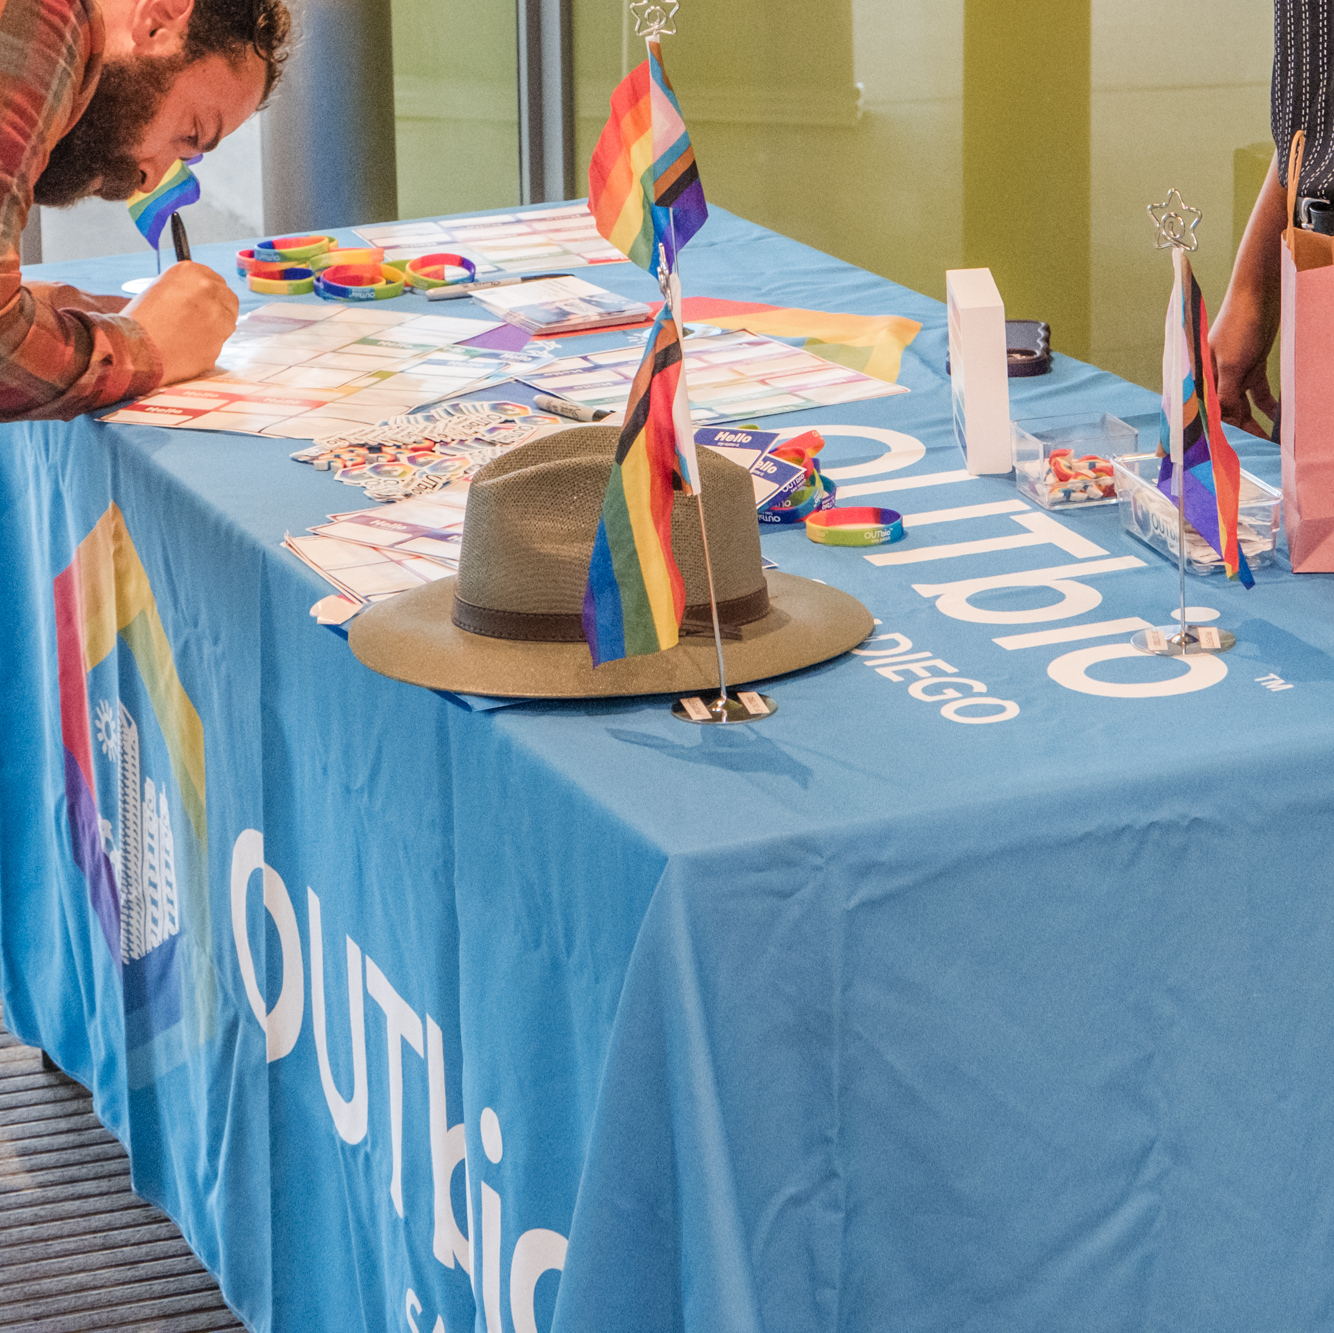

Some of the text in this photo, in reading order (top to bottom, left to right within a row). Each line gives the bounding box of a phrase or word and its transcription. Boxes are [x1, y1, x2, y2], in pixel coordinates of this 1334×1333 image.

[144, 406, 184, 415] Hello
[714, 431, 752, 444] Hello
[755, 460, 778, 474] ello
[411, 474, 442, 496] UTbio
[369, 519, 408, 531] Hello
[854, 632, 1020, 724] DIEGO
